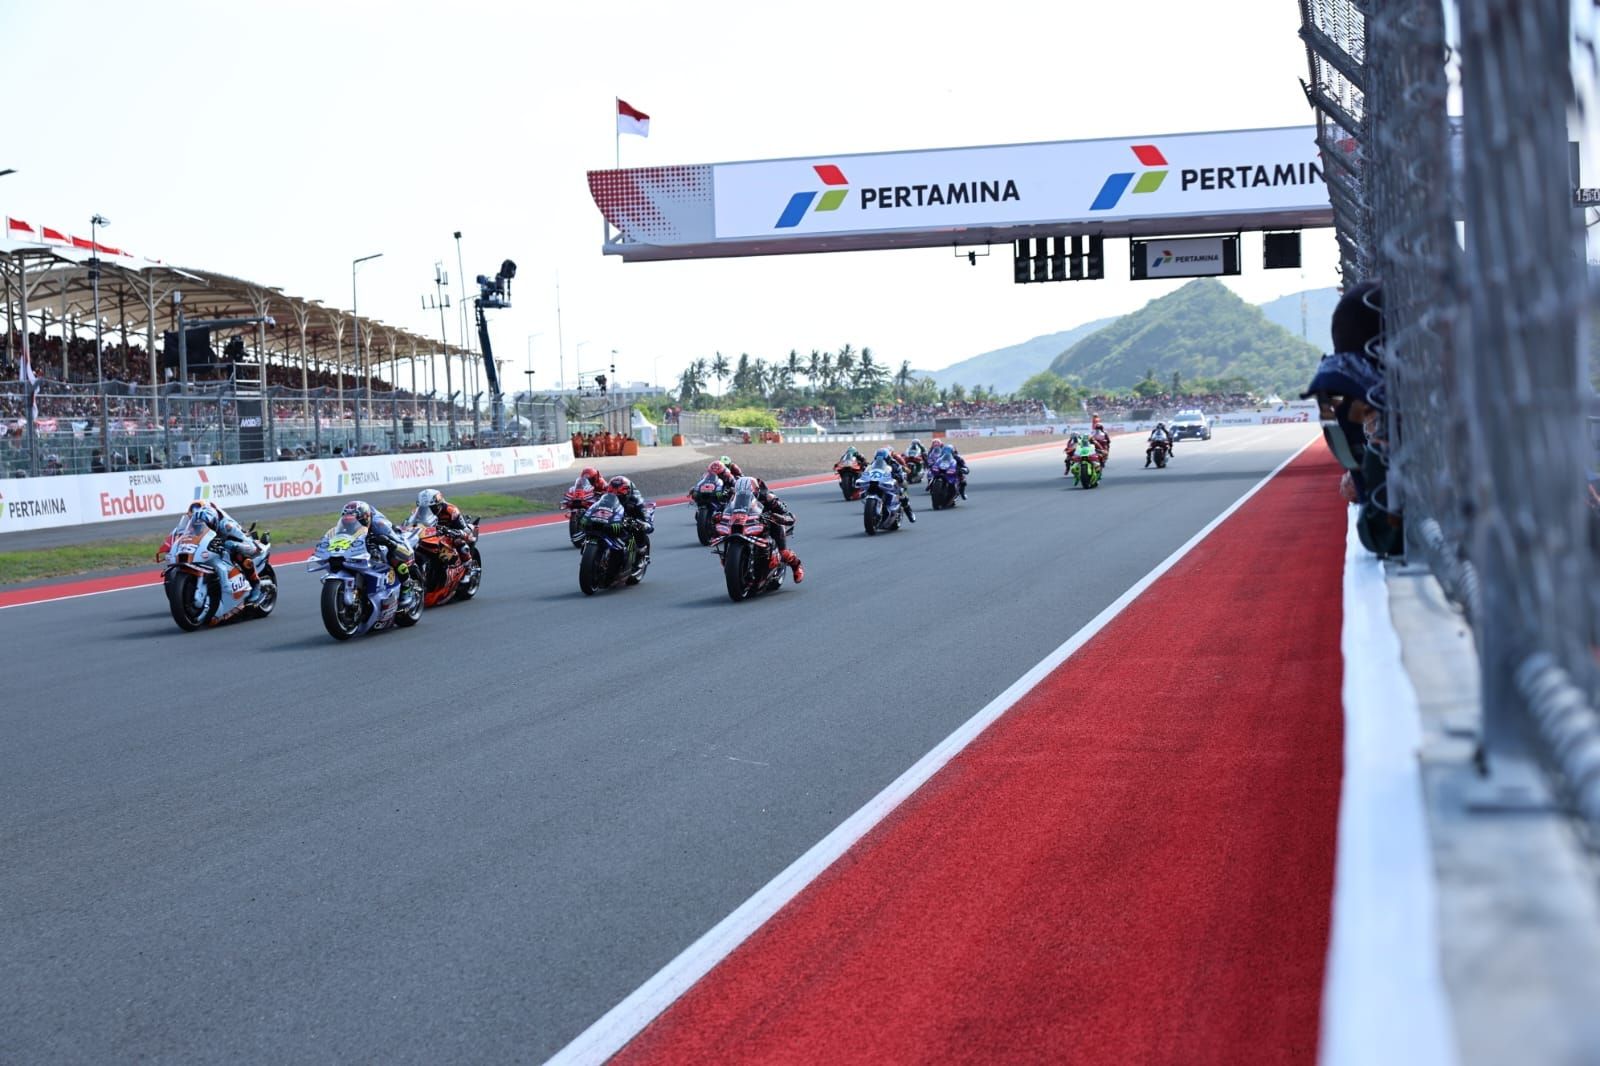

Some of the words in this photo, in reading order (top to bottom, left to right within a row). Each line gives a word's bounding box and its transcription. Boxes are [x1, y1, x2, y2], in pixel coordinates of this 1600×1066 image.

[1182, 160, 1328, 191] PERTAMIN
[861, 179, 1021, 210] PERTAMINA
[1175, 253, 1220, 264] PERTAMINA
[350, 470, 380, 485] PERTAMINA
[391, 459, 434, 480] INDONESIA
[129, 474, 162, 486] PERTAMINA
[212, 481, 249, 498] PERTAMINA
[263, 481, 314, 500] TURBO
[8, 497, 67, 518] PERTAMINA
[99, 489, 165, 517] Enduro
